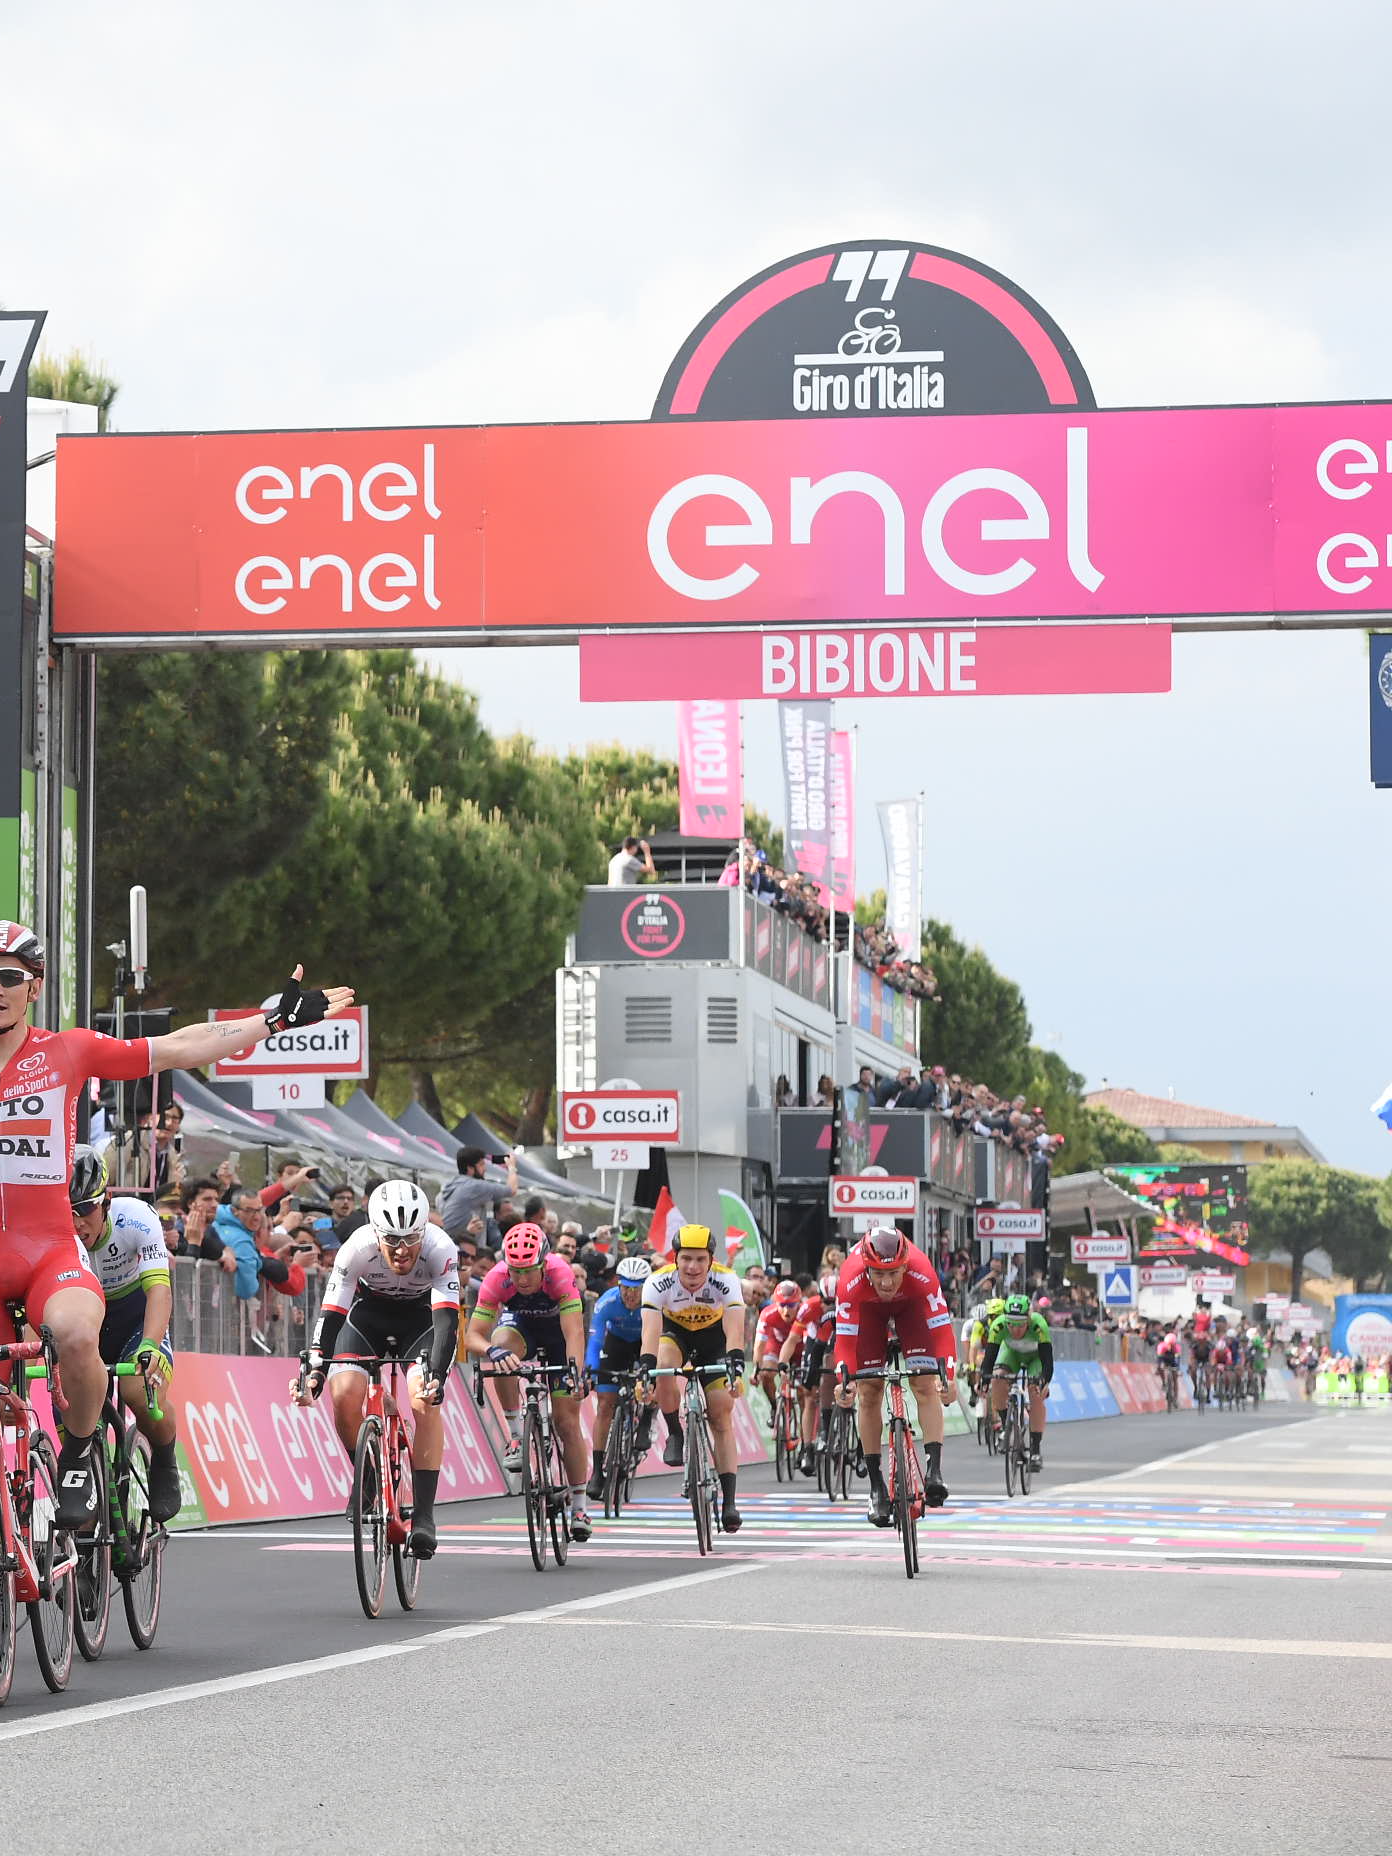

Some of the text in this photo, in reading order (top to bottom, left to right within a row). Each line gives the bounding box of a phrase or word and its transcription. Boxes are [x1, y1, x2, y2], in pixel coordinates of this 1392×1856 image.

[793, 365, 944, 411] Giro d'Italia
[235, 443, 441, 524] enel
[647, 427, 1105, 600] enel
[235, 534, 441, 614] enel
[761, 632, 976, 694] BIBIONE
[265, 1026, 349, 1052] casa.it
[19, 1065, 50, 1081] ALGIDA
[4, 1085, 25, 1098] dello
[26, 1075, 48, 1093] Sport
[278, 1084, 300, 1099] 10
[603, 1104, 669, 1123] casa.it
[611, 1149, 628, 1161] 25
[861, 1186, 908, 1200] casa.it
[185, 1371, 281, 1508] enel
[62, 1470, 88, 1488] G
